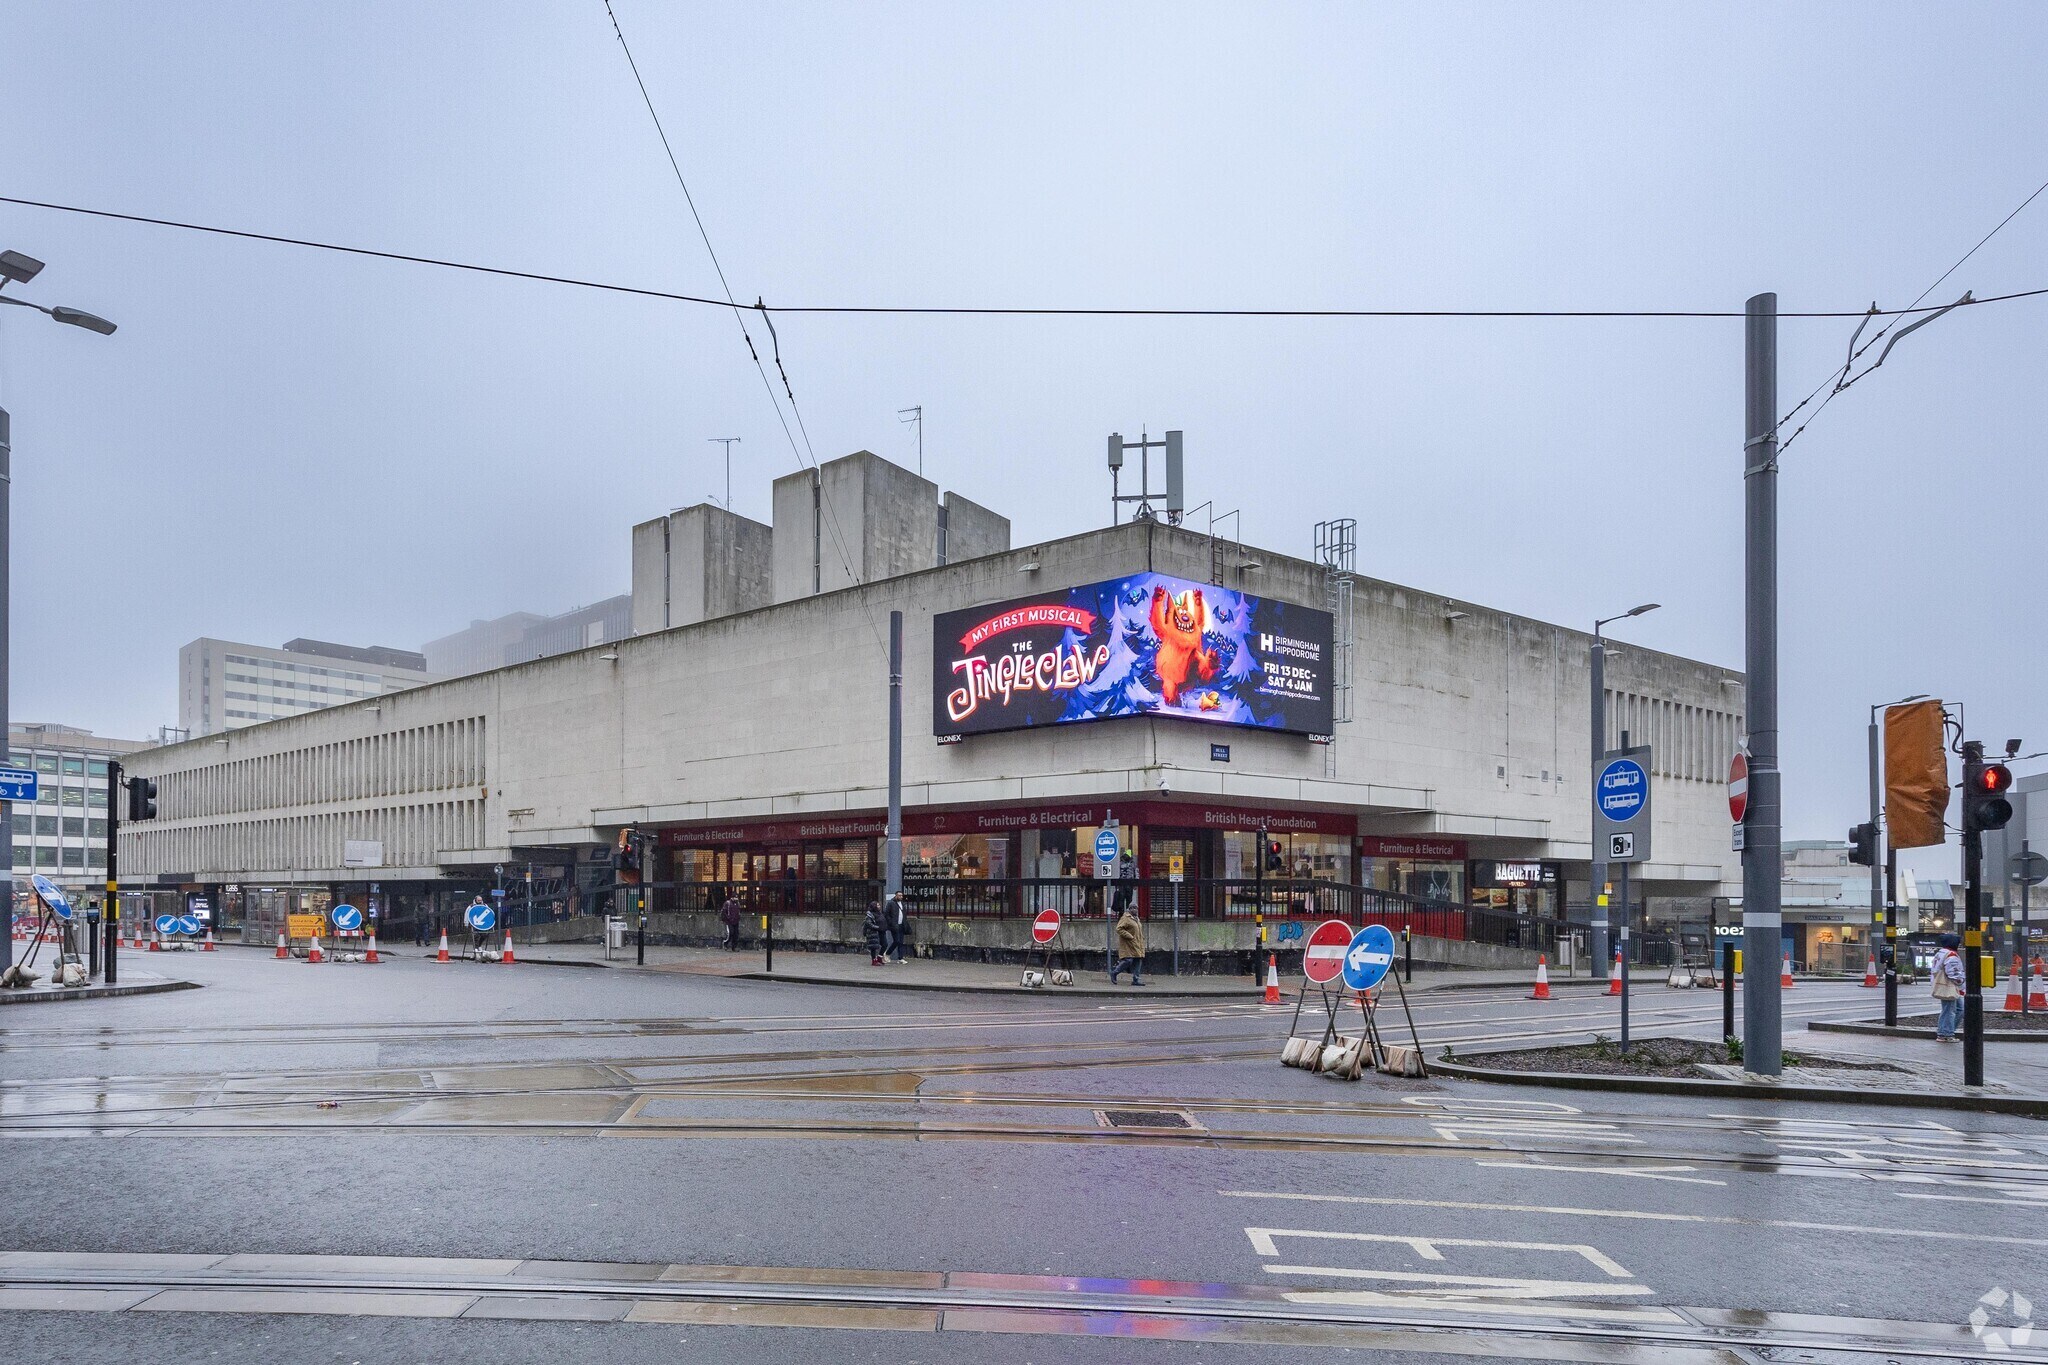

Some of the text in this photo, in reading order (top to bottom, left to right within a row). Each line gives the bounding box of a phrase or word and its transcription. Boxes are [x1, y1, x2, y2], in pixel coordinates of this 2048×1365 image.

[972, 609, 1082, 643] MY FIRST MUSICAL
[1012, 640, 1033, 652] THE
[1275, 636, 1320, 652] BIRMINGHAM
[1275, 645, 1320, 661] HIPPODROME
[1264, 662, 1279, 675] FRI
[1281, 665, 1291, 677] 13
[1292, 667, 1311, 680] DEC
[1268, 675, 1313, 692] SAT 4 JAN
[1259, 686, 1321, 701] birminghamhippodrome.com
[938, 734, 962, 743] ELONEX
[1308, 734, 1330, 742] ELONEX
[978, 810, 1092, 827] Furniture & Electrical
[1205, 811, 1317, 828] British Heart Foundation
[673, 829, 744, 842] Furniture & Electrical
[801, 825, 827, 836] British
[828, 824, 852, 834] Heart
[1379, 842, 1454, 855] Furniture & Electrical
[1495, 863, 1541, 881] BAGUETTE
